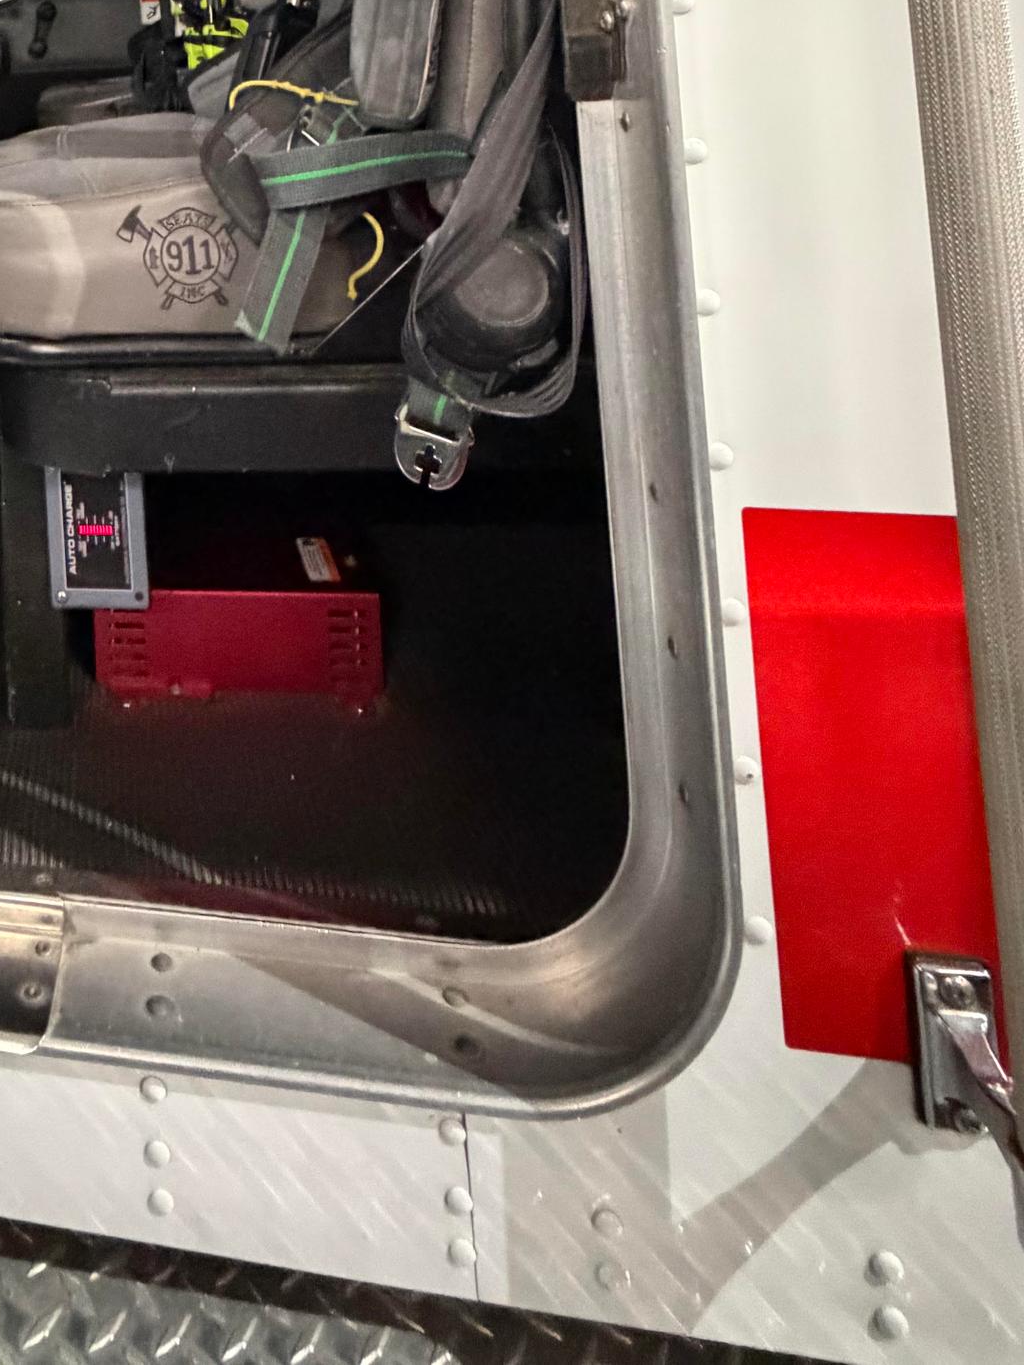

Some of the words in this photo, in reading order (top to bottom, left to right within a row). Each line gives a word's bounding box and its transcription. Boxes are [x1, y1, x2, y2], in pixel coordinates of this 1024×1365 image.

[166, 235, 215, 275] 911
[64, 484, 74, 537] CHARGE
[68, 538, 77, 575] AUTO
